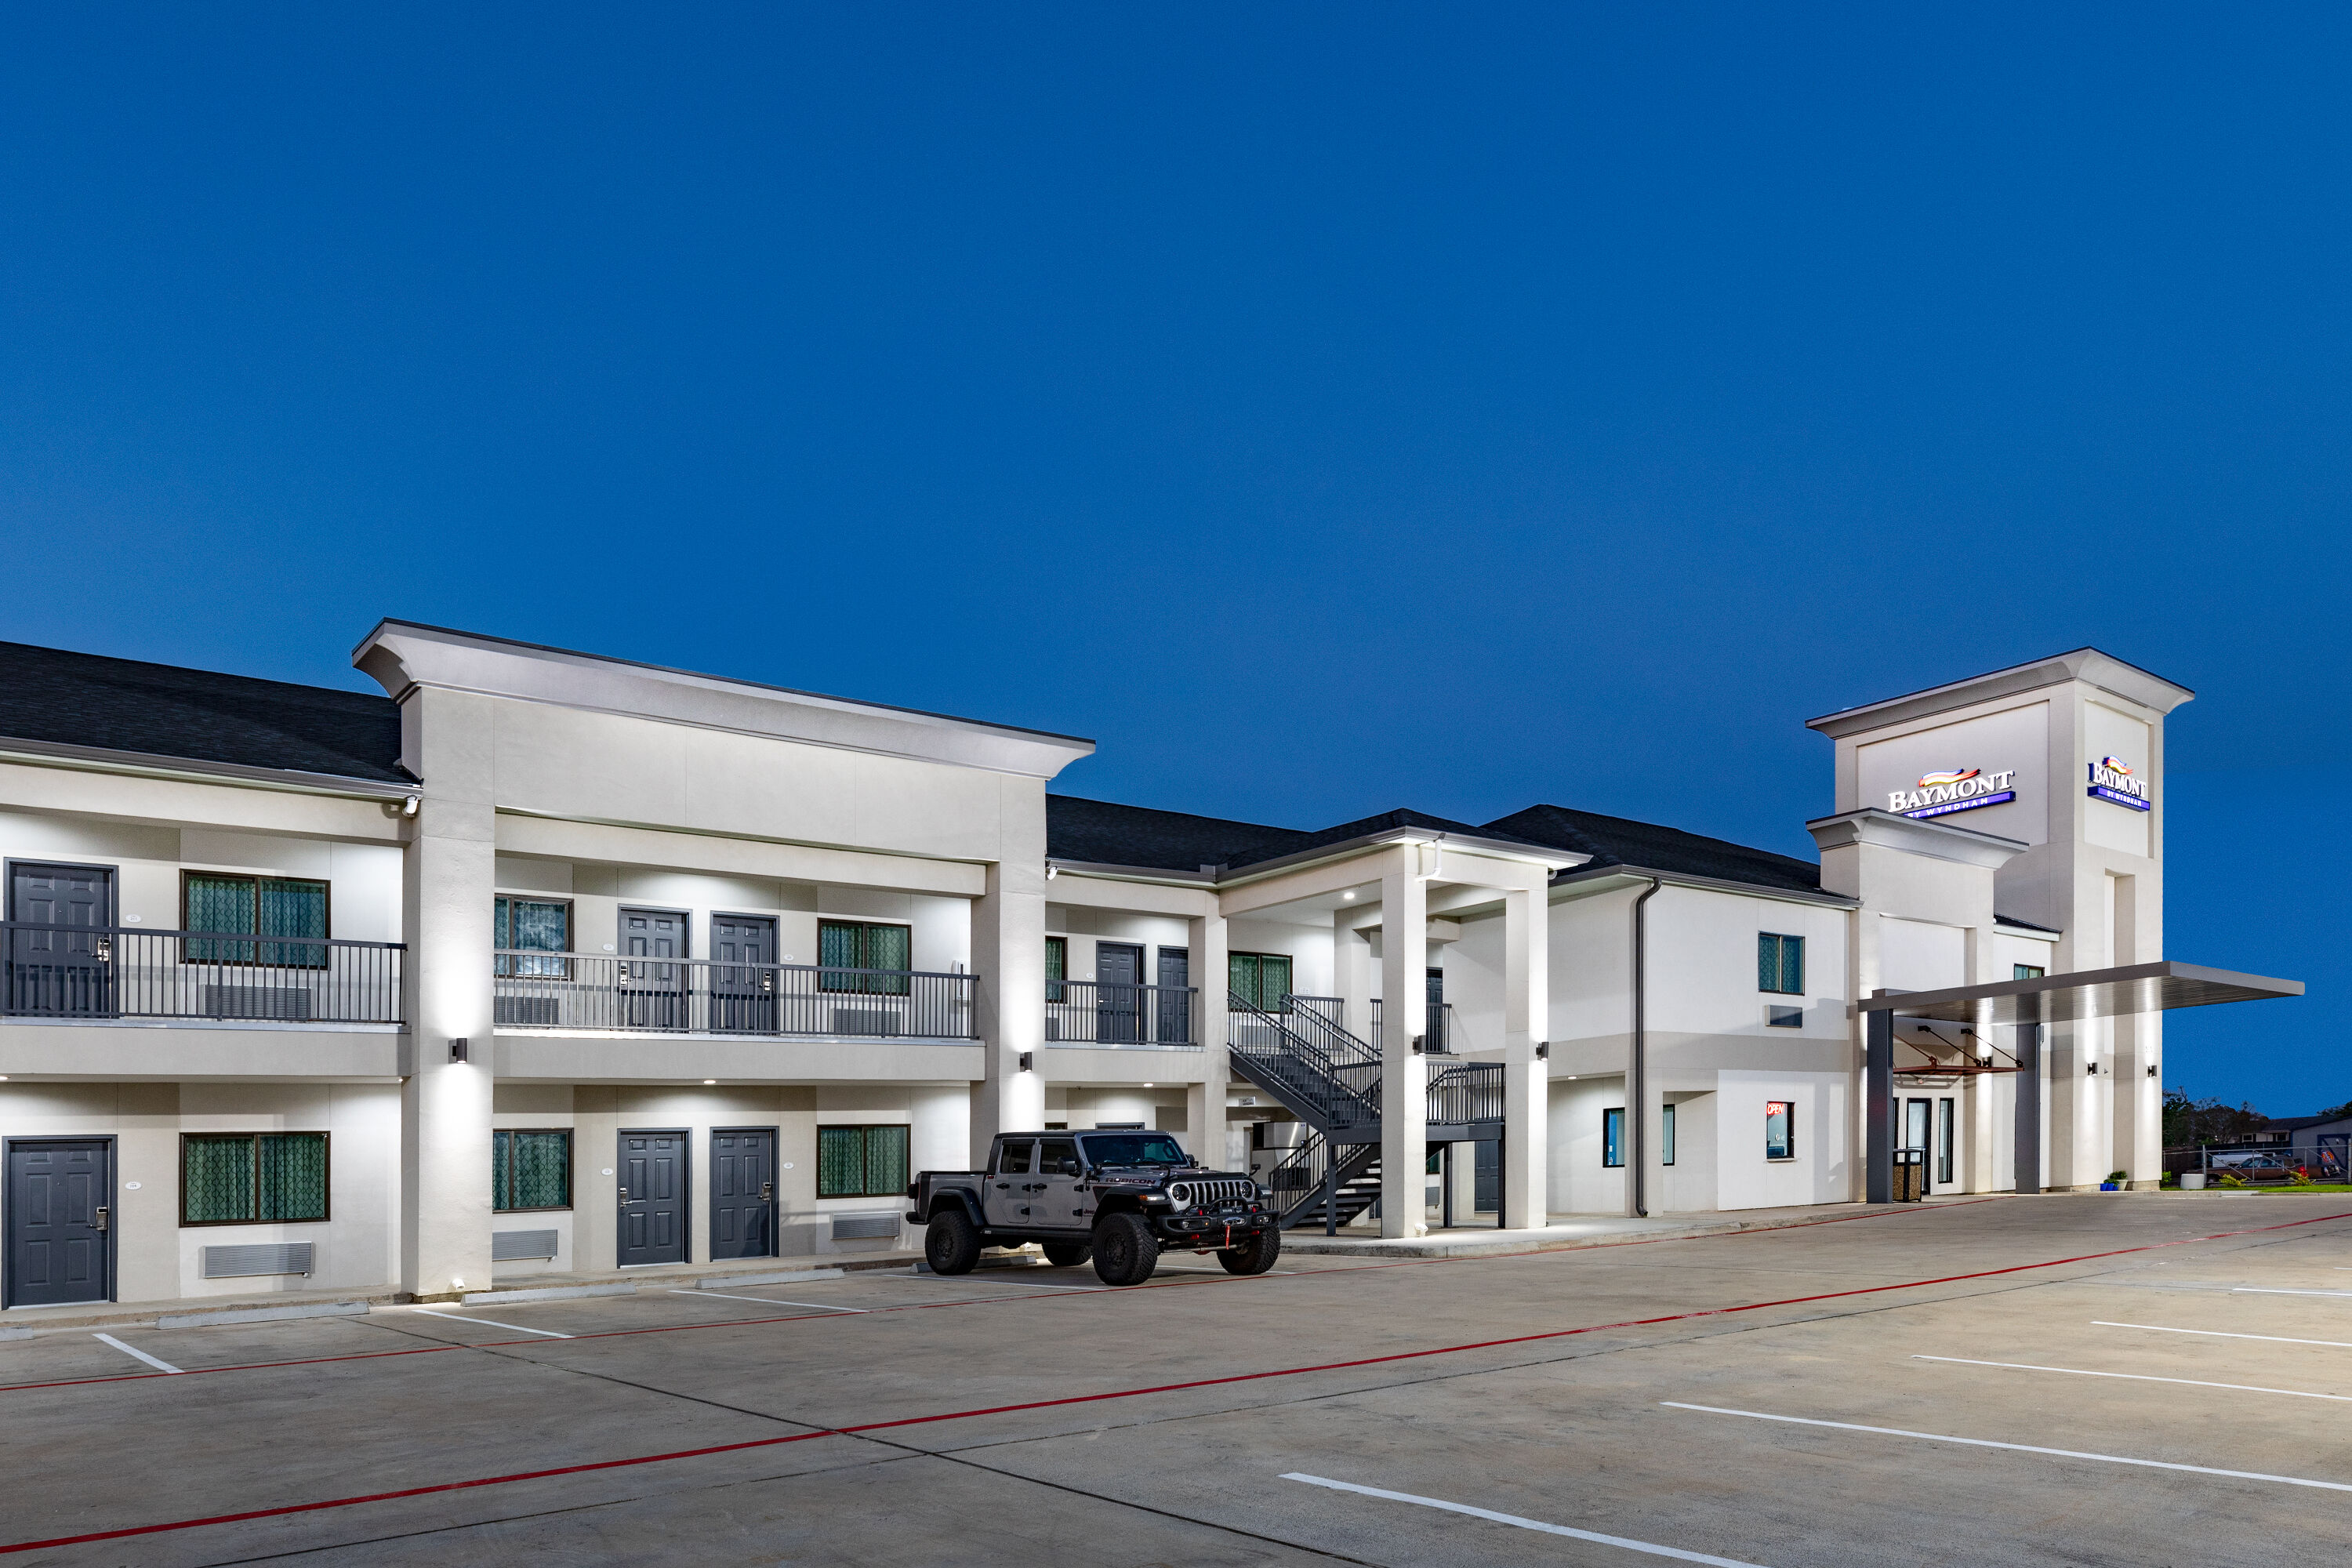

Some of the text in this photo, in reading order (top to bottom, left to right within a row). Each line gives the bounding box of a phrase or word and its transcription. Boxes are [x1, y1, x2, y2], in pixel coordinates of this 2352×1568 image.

[2093, 762, 2147, 797] BAYMONT
[1888, 770, 2015, 812] BAYMONT
[2115, 793, 2142, 806] WYNDHAM
[1926, 797, 1988, 815] WYNDHAM
[1767, 1104, 1784, 1114] OPEN
